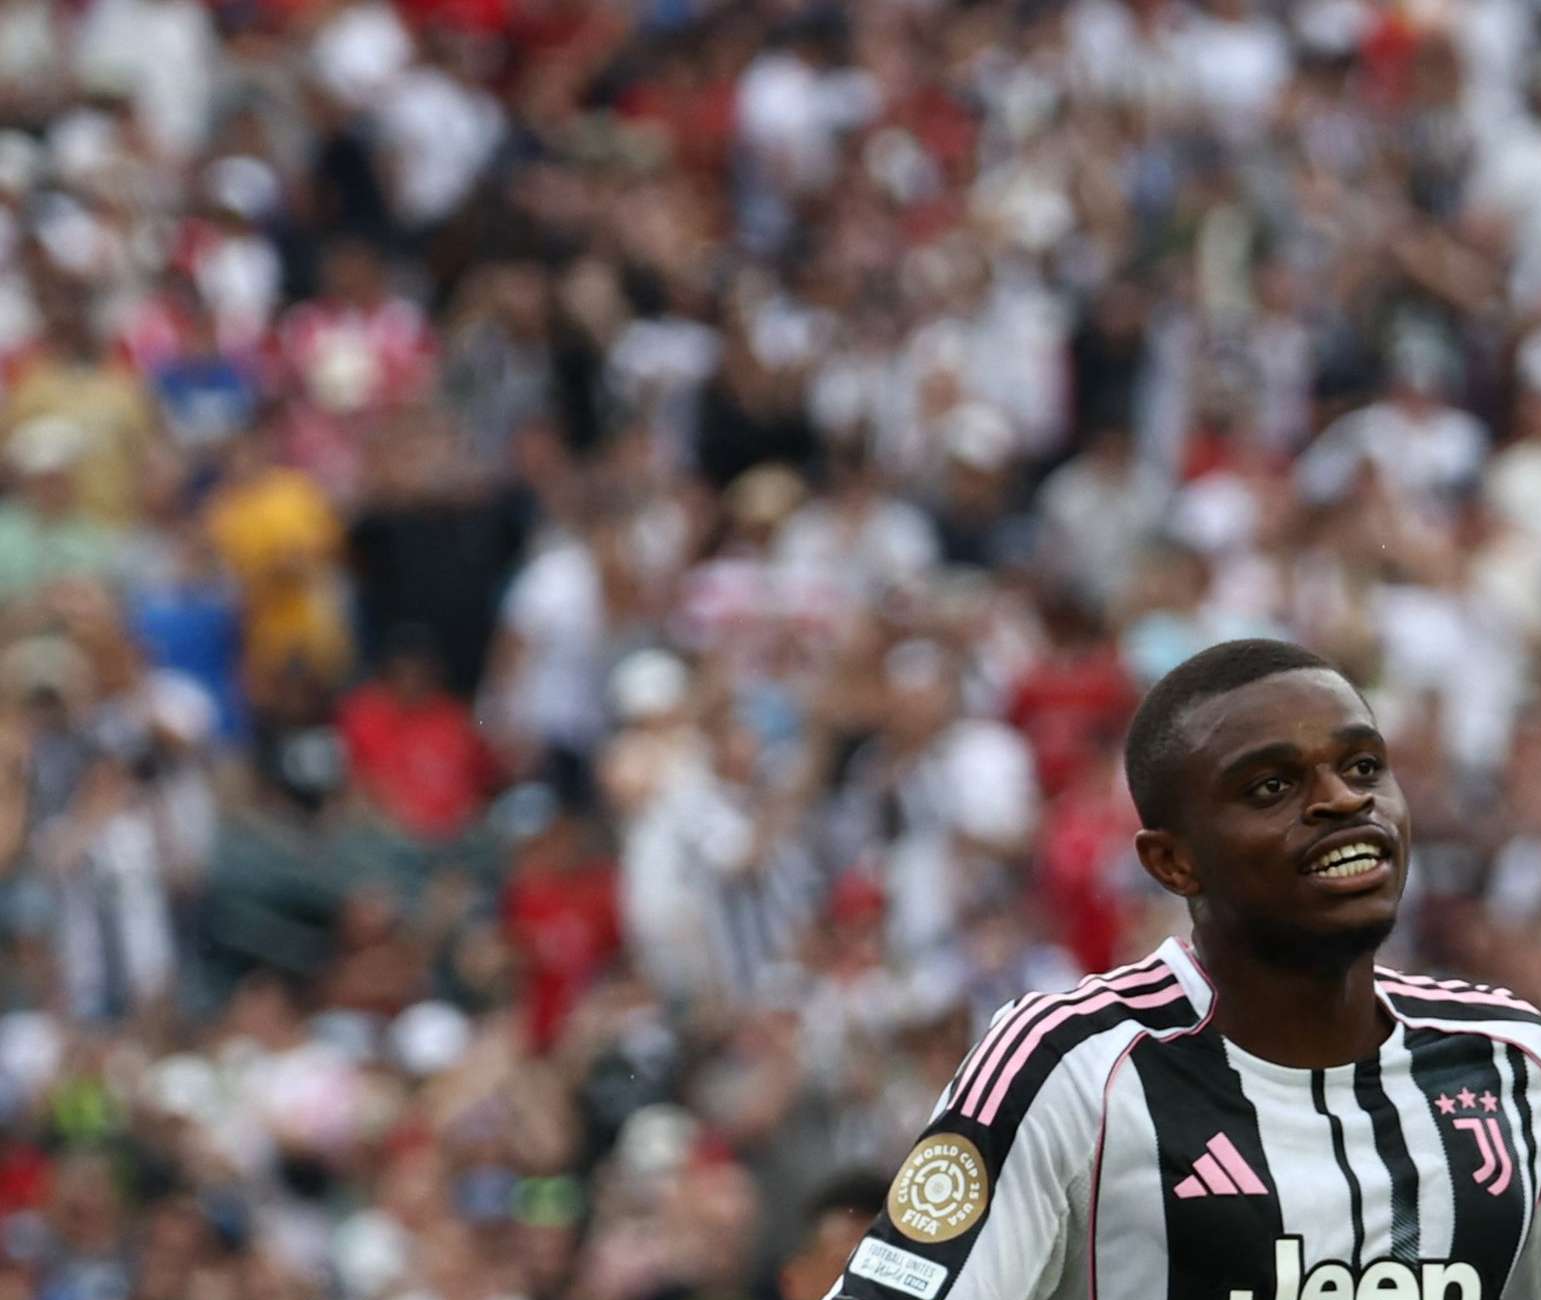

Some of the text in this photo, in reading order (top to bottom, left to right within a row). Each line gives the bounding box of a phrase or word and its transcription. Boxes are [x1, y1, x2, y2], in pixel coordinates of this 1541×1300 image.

[913, 1145, 959, 1168] WORLD
[959, 1152, 979, 1178] CUP
[901, 1209, 940, 1237] FIFA
[947, 1203, 975, 1227] USA
